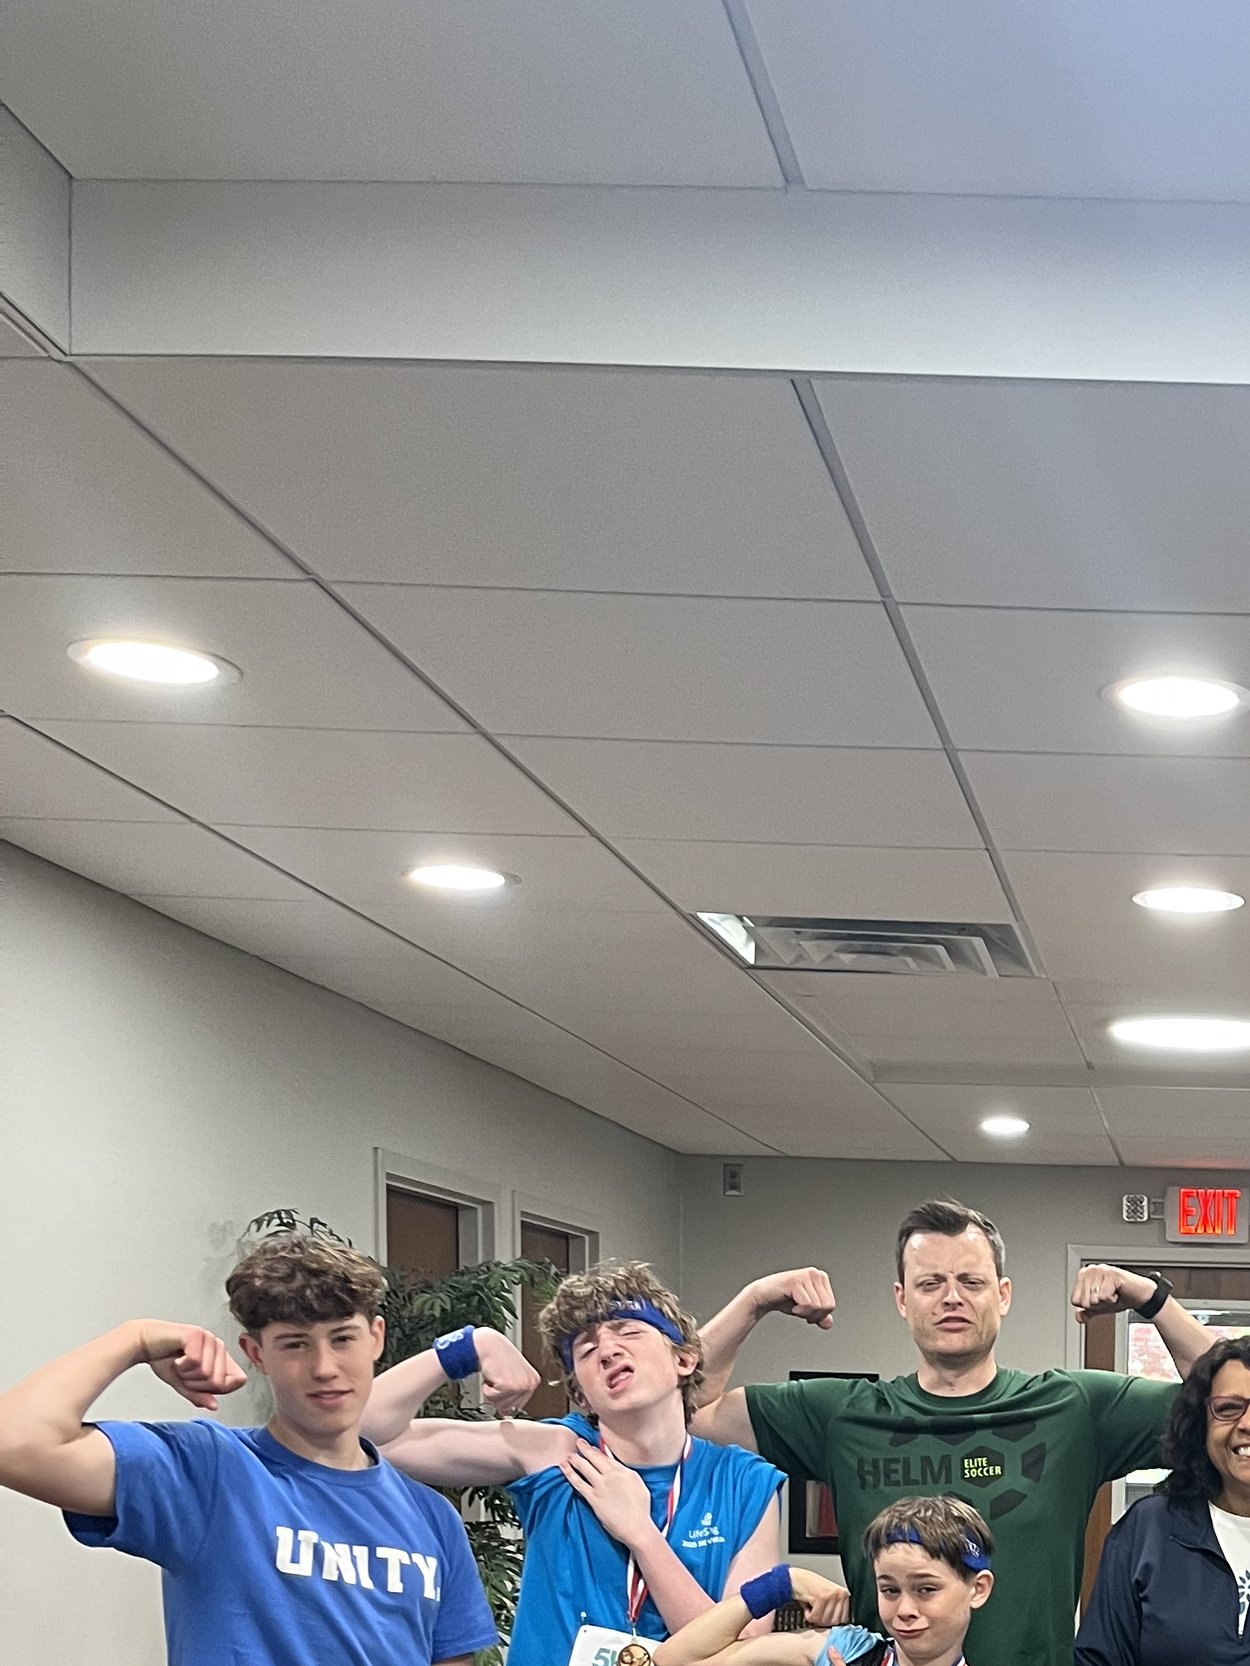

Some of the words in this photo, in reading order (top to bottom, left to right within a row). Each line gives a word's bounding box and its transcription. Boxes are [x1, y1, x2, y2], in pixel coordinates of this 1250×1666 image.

[1180, 1188, 1241, 1235] EXIT
[857, 1454, 953, 1491] HELM
[964, 1457, 988, 1468] ELITE
[964, 1465, 1002, 1478] SOCCER
[276, 1526, 440, 1601] UNITY
